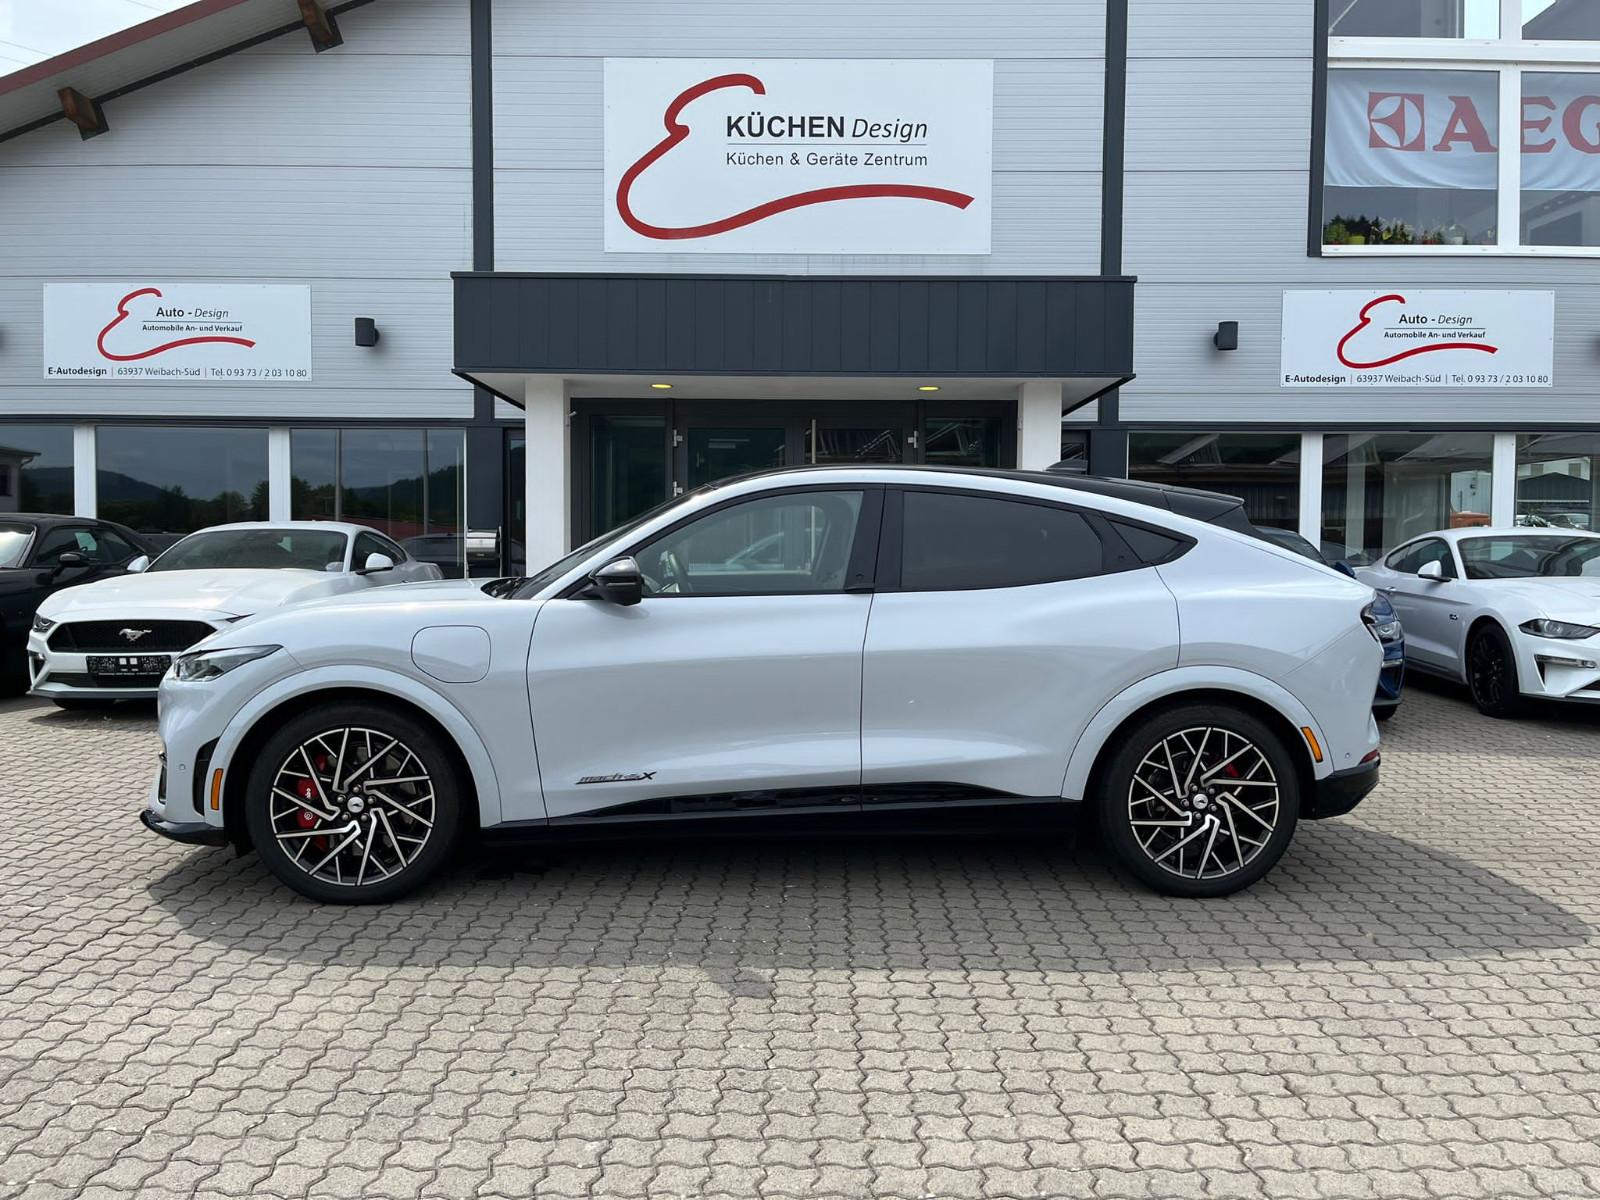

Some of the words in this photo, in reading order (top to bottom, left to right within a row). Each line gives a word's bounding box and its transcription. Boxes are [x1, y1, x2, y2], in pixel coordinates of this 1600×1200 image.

[727, 111, 845, 138] KÜCHEN
[852, 118, 928, 144] Design
[726, 152, 784, 166] Küchen
[790, 152, 801, 166] &
[806, 152, 858, 166] Geräte
[864, 152, 928, 167] Zentrum
[155, 306, 185, 318] Auto
[194, 308, 229, 320] Design
[1397, 313, 1429, 325] Auto
[1437, 314, 1473, 327] Design
[142, 324, 184, 332] Automobile
[1384, 331, 1427, 339] Automobile
[1428, 331, 1441, 339] An-
[1442, 331, 1456, 339] und
[1457, 331, 1486, 339] Verkauf
[47, 367, 107, 377] E-Autodesign
[117, 367, 143, 376] 63937
[211, 368, 225, 377] Tel.
[234, 368, 245, 377] 93
[247, 369, 257, 377] 73
[271, 369, 282, 377] 03
[285, 369, 295, 377] 10
[296, 369, 307, 378] 80
[1285, 374, 1346, 385] E-Autodesign
[1356, 374, 1383, 383] 63937
[1384, 374, 1442, 383] Weibach-Süd
[1451, 374, 1466, 383] Tel.
[1475, 375, 1486, 383] 93
[1488, 375, 1498, 383] 73
[1512, 375, 1524, 383] 03
[1526, 375, 1536, 383] 10
[1537, 375, 1549, 383] 80
